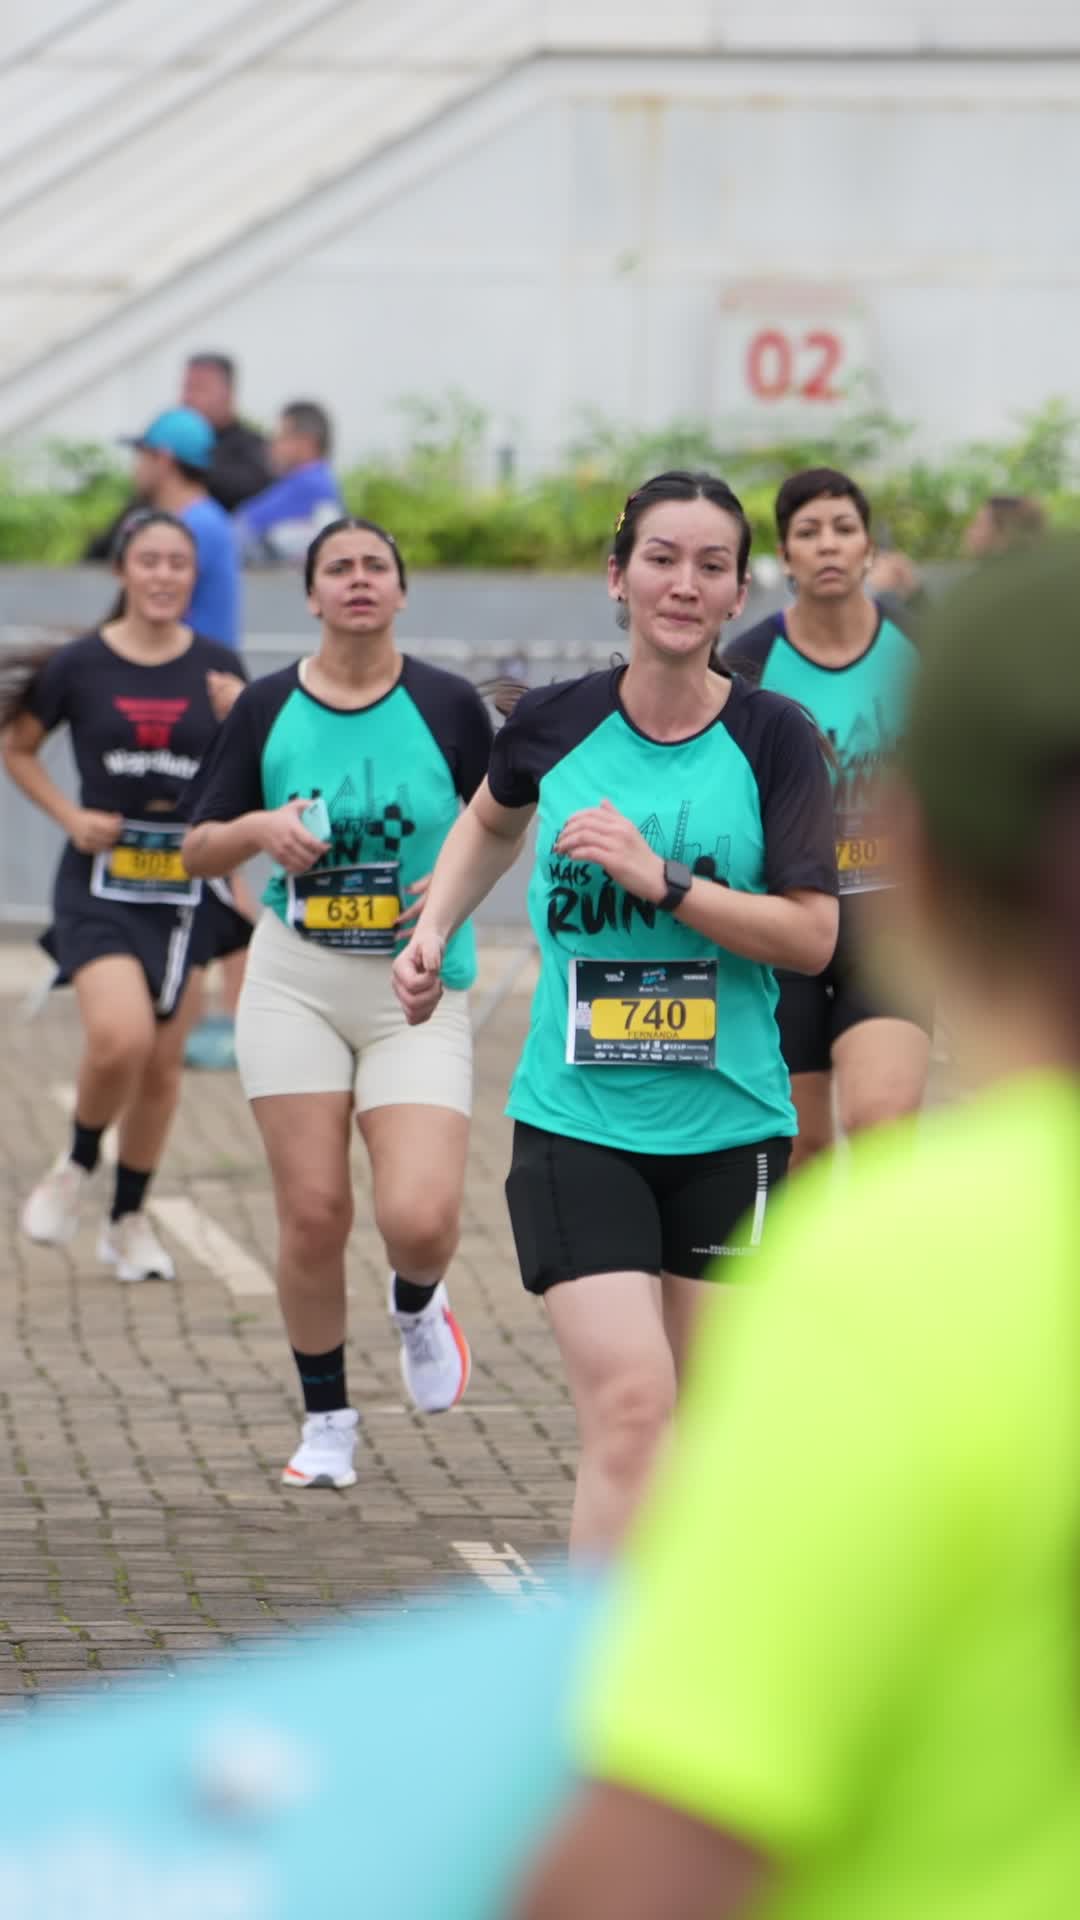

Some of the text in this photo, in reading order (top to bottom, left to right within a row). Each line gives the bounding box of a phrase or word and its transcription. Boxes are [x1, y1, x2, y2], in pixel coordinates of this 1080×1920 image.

[745, 328, 846, 404] 02
[837, 841, 876, 863] 780
[550, 863, 592, 886] MAIS
[327, 897, 374, 922] 631
[547, 885, 656, 936] RUN
[621, 1000, 686, 1030] 740
[627, 1031, 680, 1040] FERNANDA
